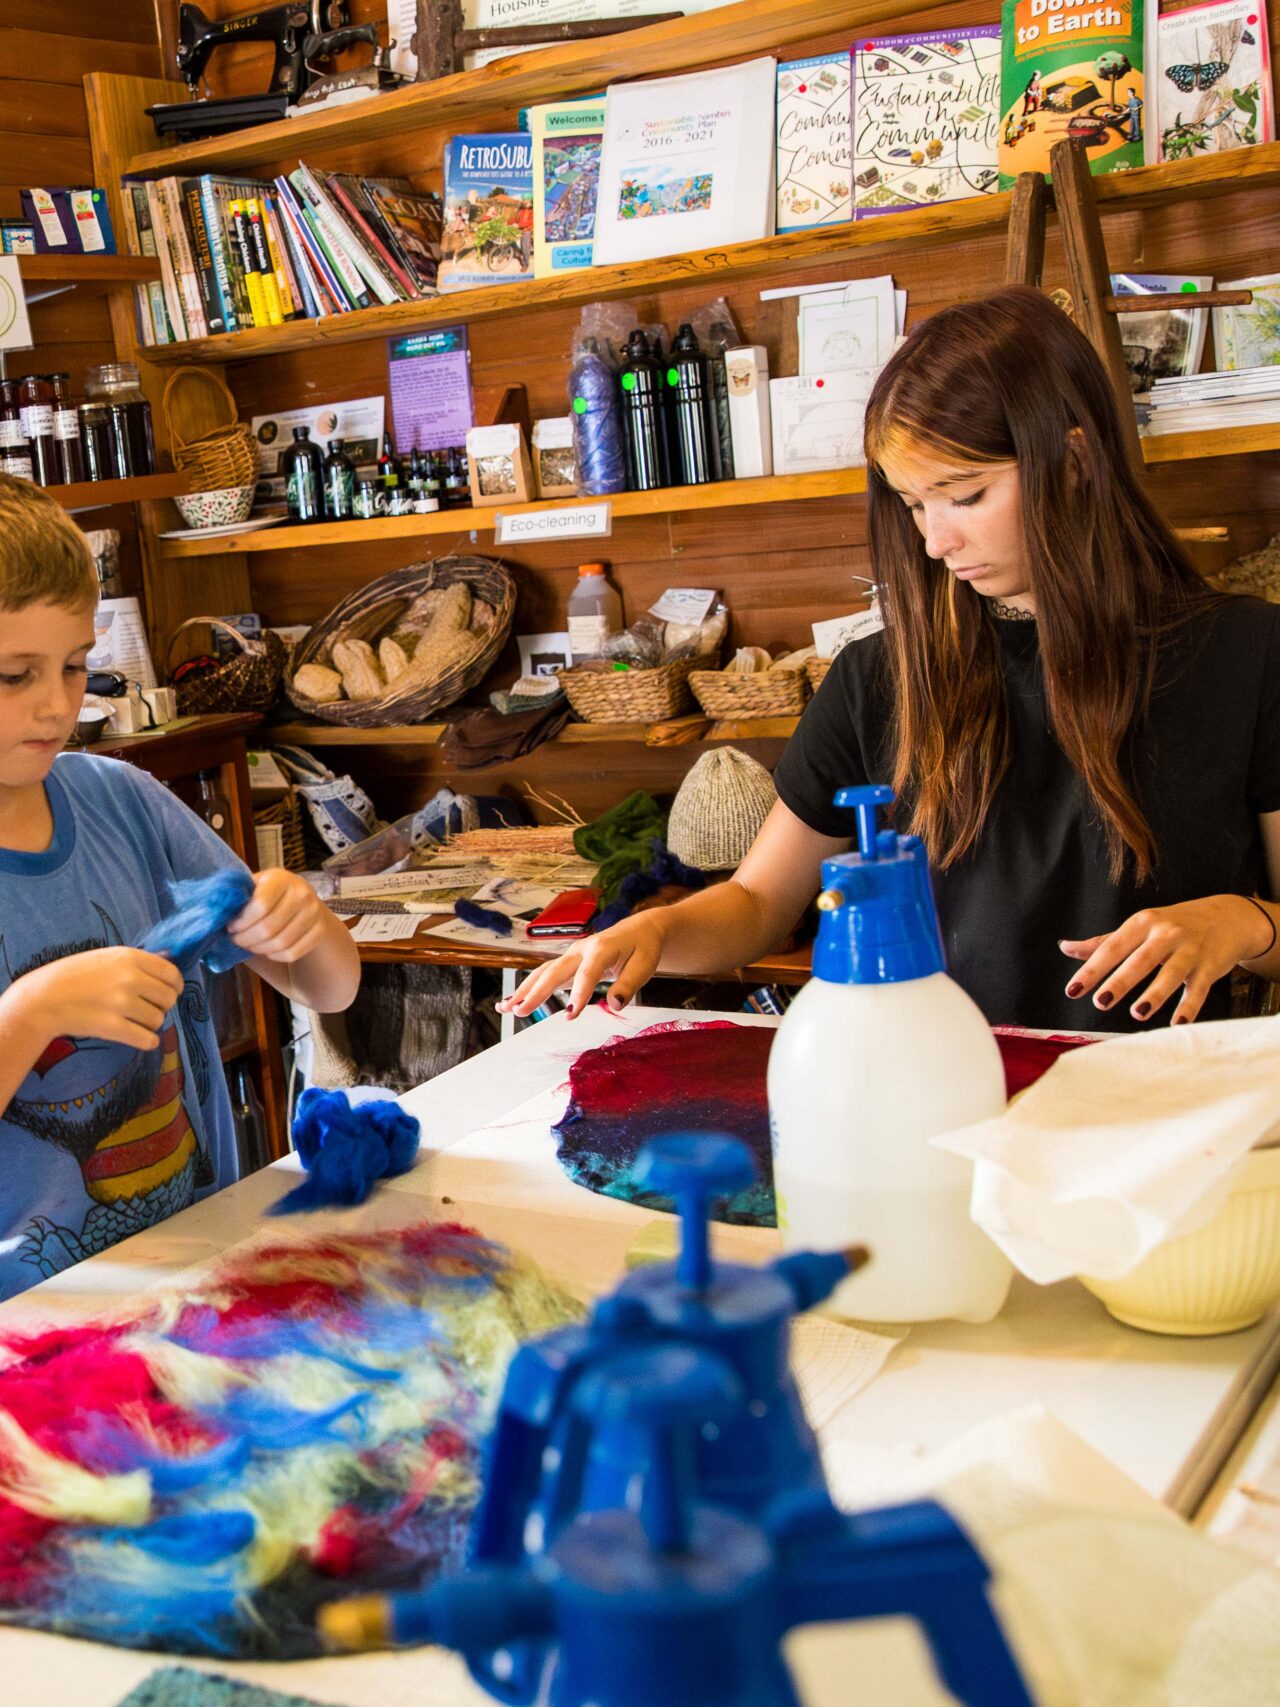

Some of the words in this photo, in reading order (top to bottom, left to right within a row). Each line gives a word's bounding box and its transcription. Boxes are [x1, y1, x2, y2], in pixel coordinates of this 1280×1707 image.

[224, 16, 257, 32] SINGER
[1017, 24, 1040, 45] to
[1047, 11, 1122, 35] Earth
[1162, 18, 1187, 30] Create
[1189, 14, 1207, 26] More
[1208, 5, 1249, 20] Butterflies
[911, 31, 970, 43] COMMUNITIES
[789, 58, 821, 70] WISDOM
[549, 114, 598, 125] Welcome
[697, 120, 717, 129] Plan
[926, 101, 953, 126] in
[643, 137, 672, 149] 2016
[684, 130, 714, 143] 2021
[189, 190, 213, 269] PERMACULTURE
[200, 180, 223, 252] SUSTAINABLE
[215, 254, 230, 292] HOUSE
[234, 216, 247, 243] Raising
[252, 223, 264, 248] Chicken
[239, 242, 254, 274] Chickens
[256, 247, 269, 269] Health
[319, 222, 344, 260] MYCELIUM
[339, 257, 362, 292] RUNNING
[557, 247, 586, 257] Caring
[562, 256, 592, 265] Culture
[509, 511, 597, 534] Eco-cleaning
